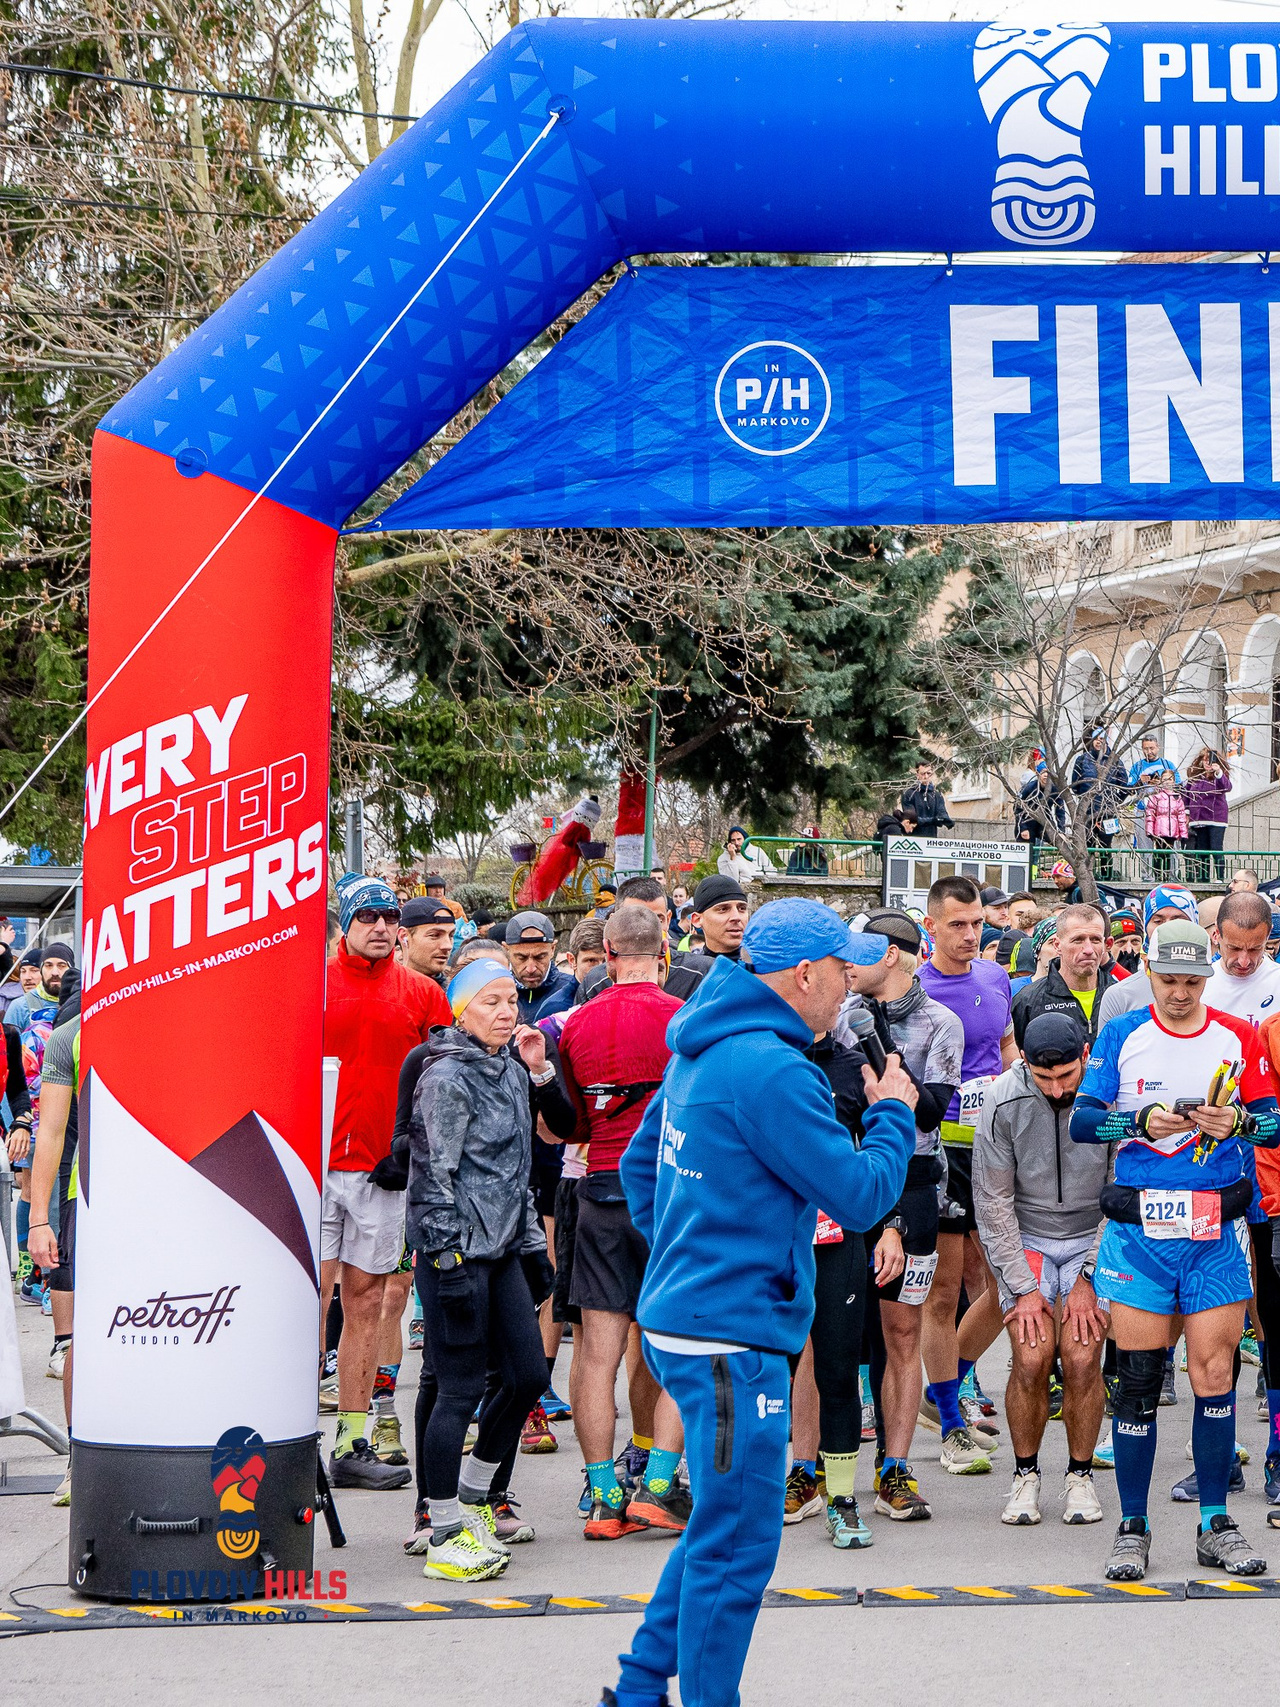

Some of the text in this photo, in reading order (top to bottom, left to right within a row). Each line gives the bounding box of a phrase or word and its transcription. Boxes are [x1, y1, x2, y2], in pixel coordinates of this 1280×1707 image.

[764, 364, 780, 373] IN
[736, 378, 810, 414] P/H
[737, 417, 810, 427] MARKOVO
[84, 693, 249, 832] VERY
[129, 753, 307, 884] STEP
[926, 840, 1026, 852] ИНФОРМАЦИОННО ТАБЛО
[951, 851, 1002, 860] с.МАРКОВО
[1170, 946, 1197, 956] UTMB
[1044, 1001, 1077, 1011] GIVOVA
[1145, 1201, 1187, 1220] 2124
[121, 1335, 179, 1345] STUDIO
[1204, 1405, 1232, 1414] UTMB
[1118, 1421, 1149, 1432] UTMB
